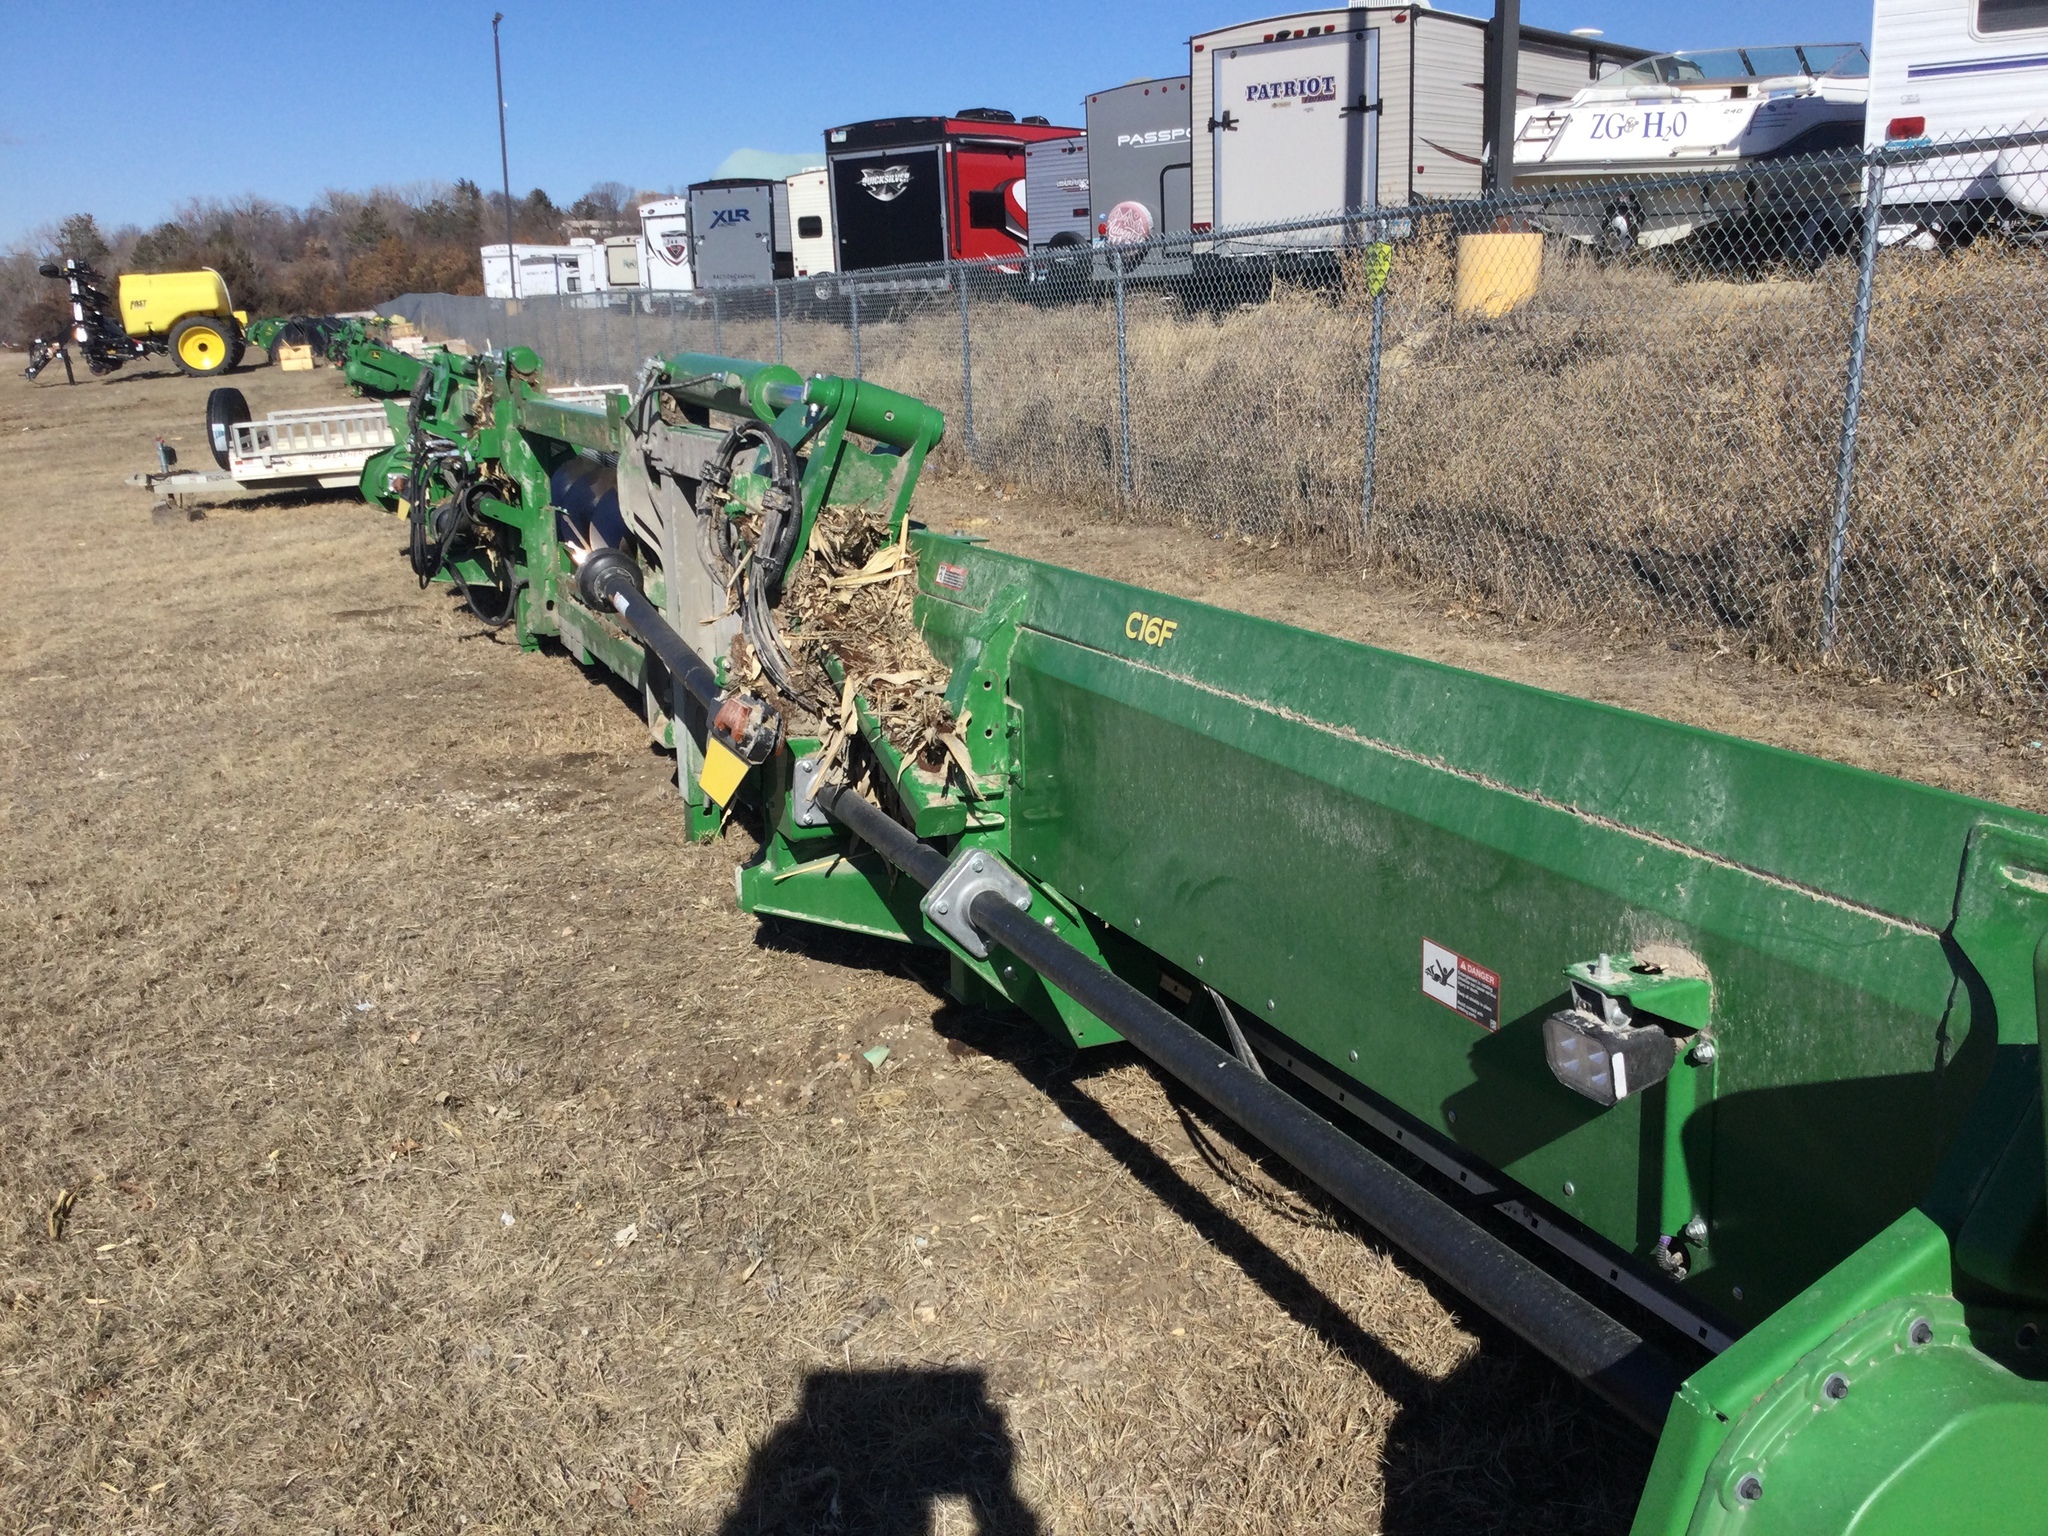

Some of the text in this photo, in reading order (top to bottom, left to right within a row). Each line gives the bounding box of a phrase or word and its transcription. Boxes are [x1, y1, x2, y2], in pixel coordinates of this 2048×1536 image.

[1246, 76, 1335, 102] PATRIOT
[1589, 112, 1625, 139] ZG
[861, 172, 910, 187] QUICKSILVER
[709, 208, 751, 230] XLR
[130, 299, 147, 310] FAST
[1125, 611, 1178, 648] C16F
[1467, 964, 1495, 985] DANGER
